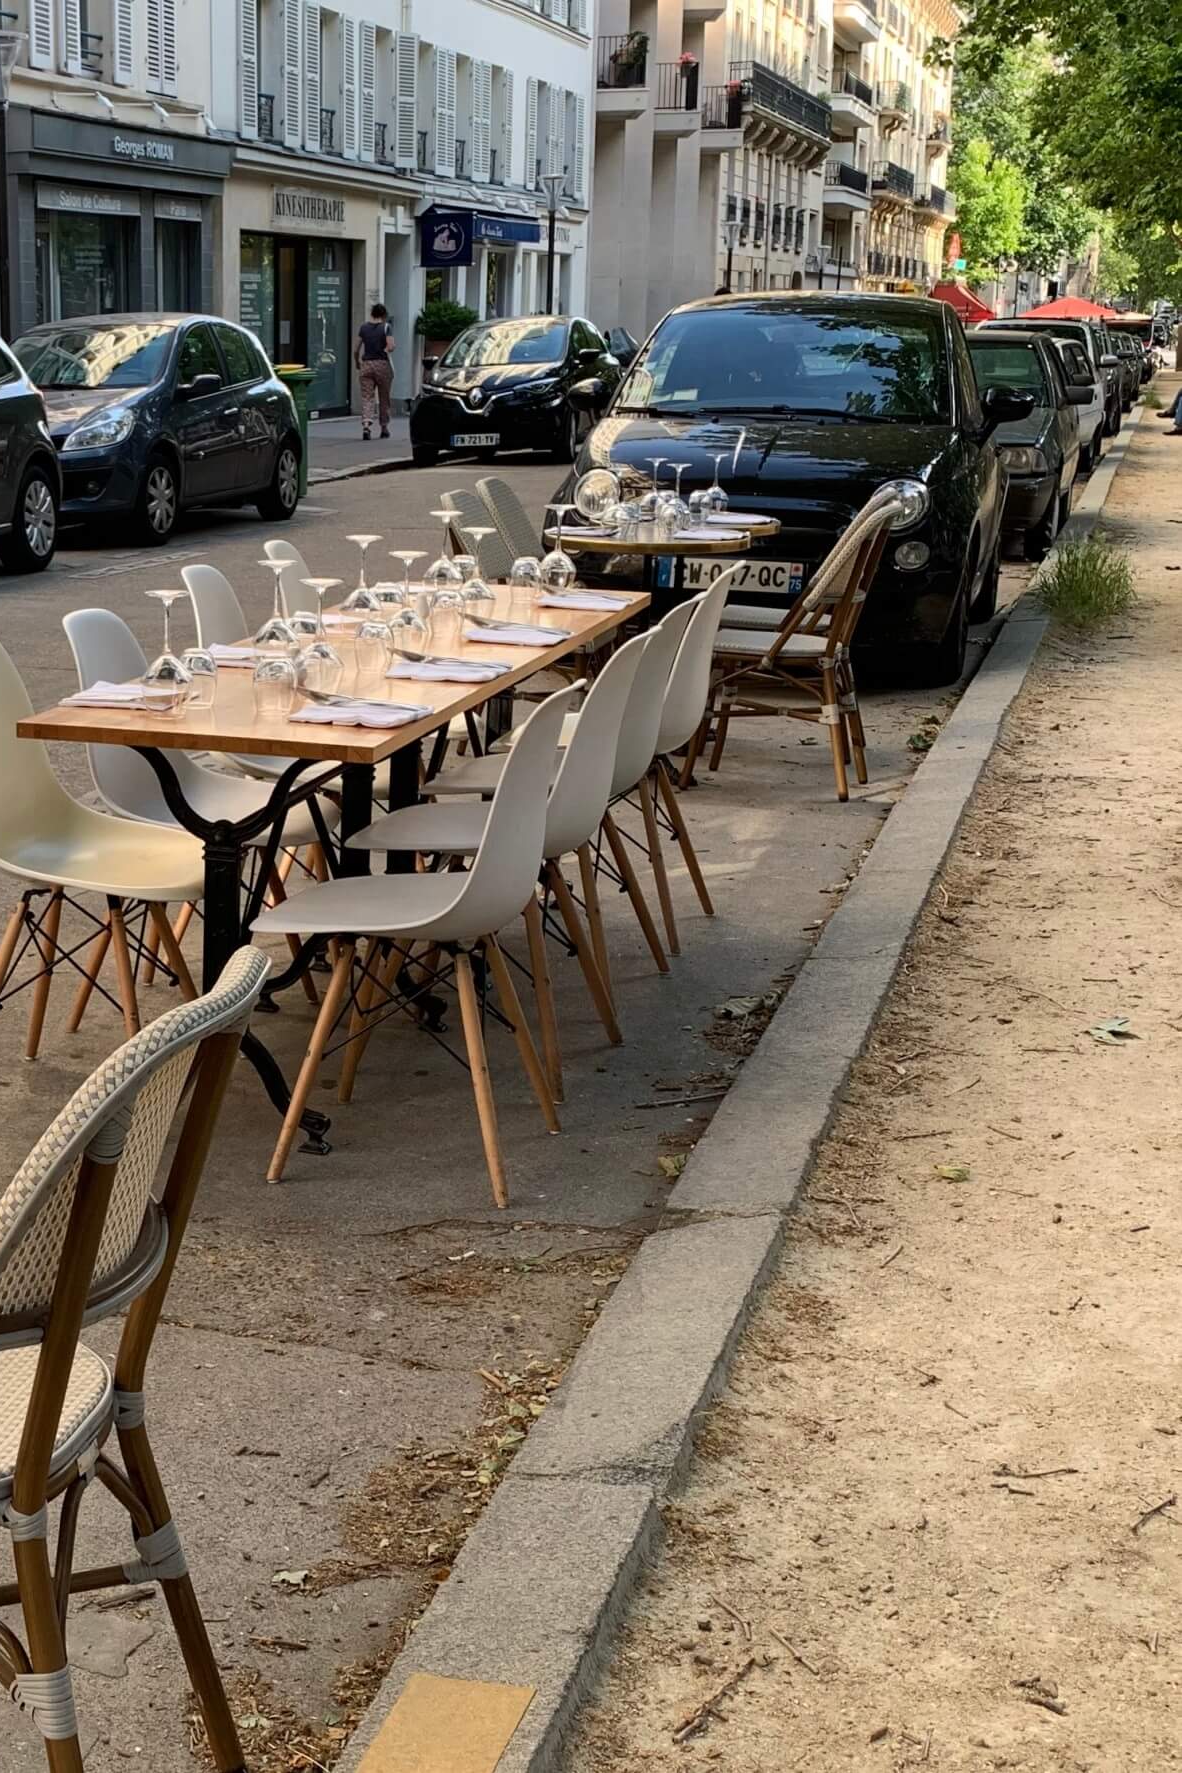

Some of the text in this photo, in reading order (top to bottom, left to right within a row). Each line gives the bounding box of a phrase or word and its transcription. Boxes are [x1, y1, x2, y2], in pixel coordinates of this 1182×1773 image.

[114, 137, 174, 160] Georges ROMAN
[275, 193, 346, 222] KINESITHERAPIE
[790, 578, 802, 590] 75
